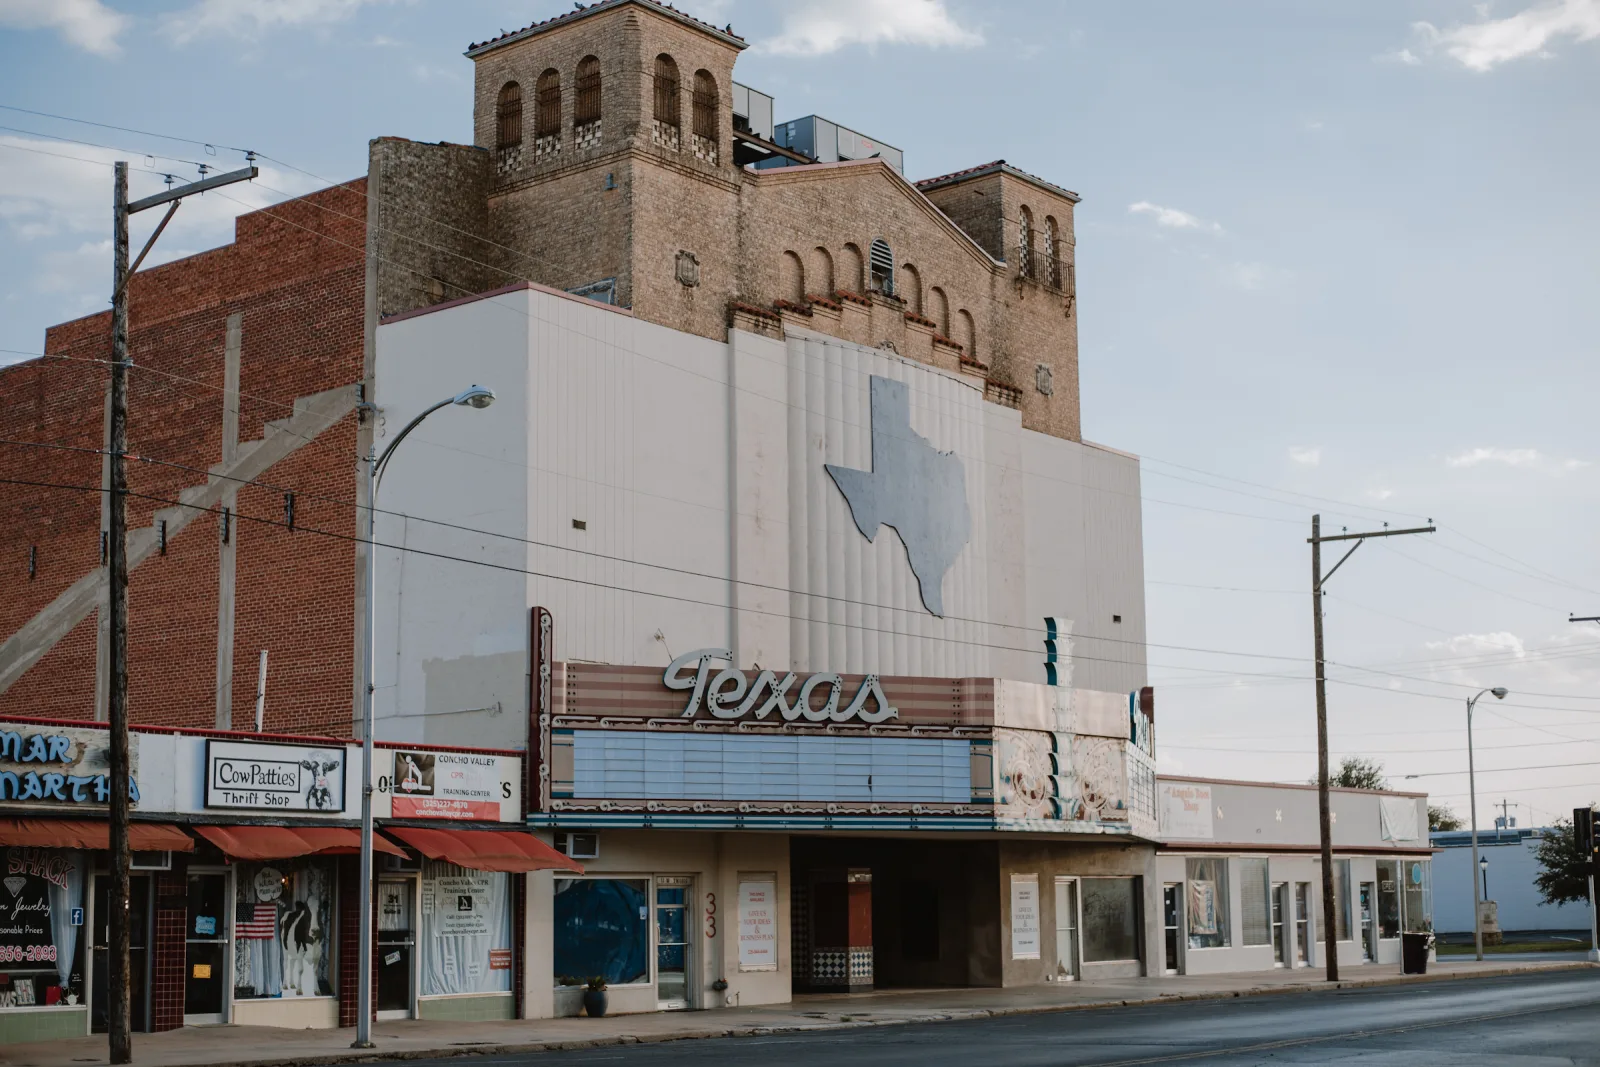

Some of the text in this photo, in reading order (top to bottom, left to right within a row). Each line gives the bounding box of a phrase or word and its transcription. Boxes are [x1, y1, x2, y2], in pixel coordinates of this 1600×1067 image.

[663, 648, 899, 723] Texas
[439, 755, 496, 767] CONCHO VALLEY
[451, 771, 464, 779] CPR
[443, 788, 490, 797] TRAINING CENTER
[223, 792, 290, 806] Thrift Shop
[8, 848, 76, 890] SHACK
[388, 894, 398, 903] 31
[11, 897, 51, 920] Jewelry
[25, 924, 44, 934] Prices
